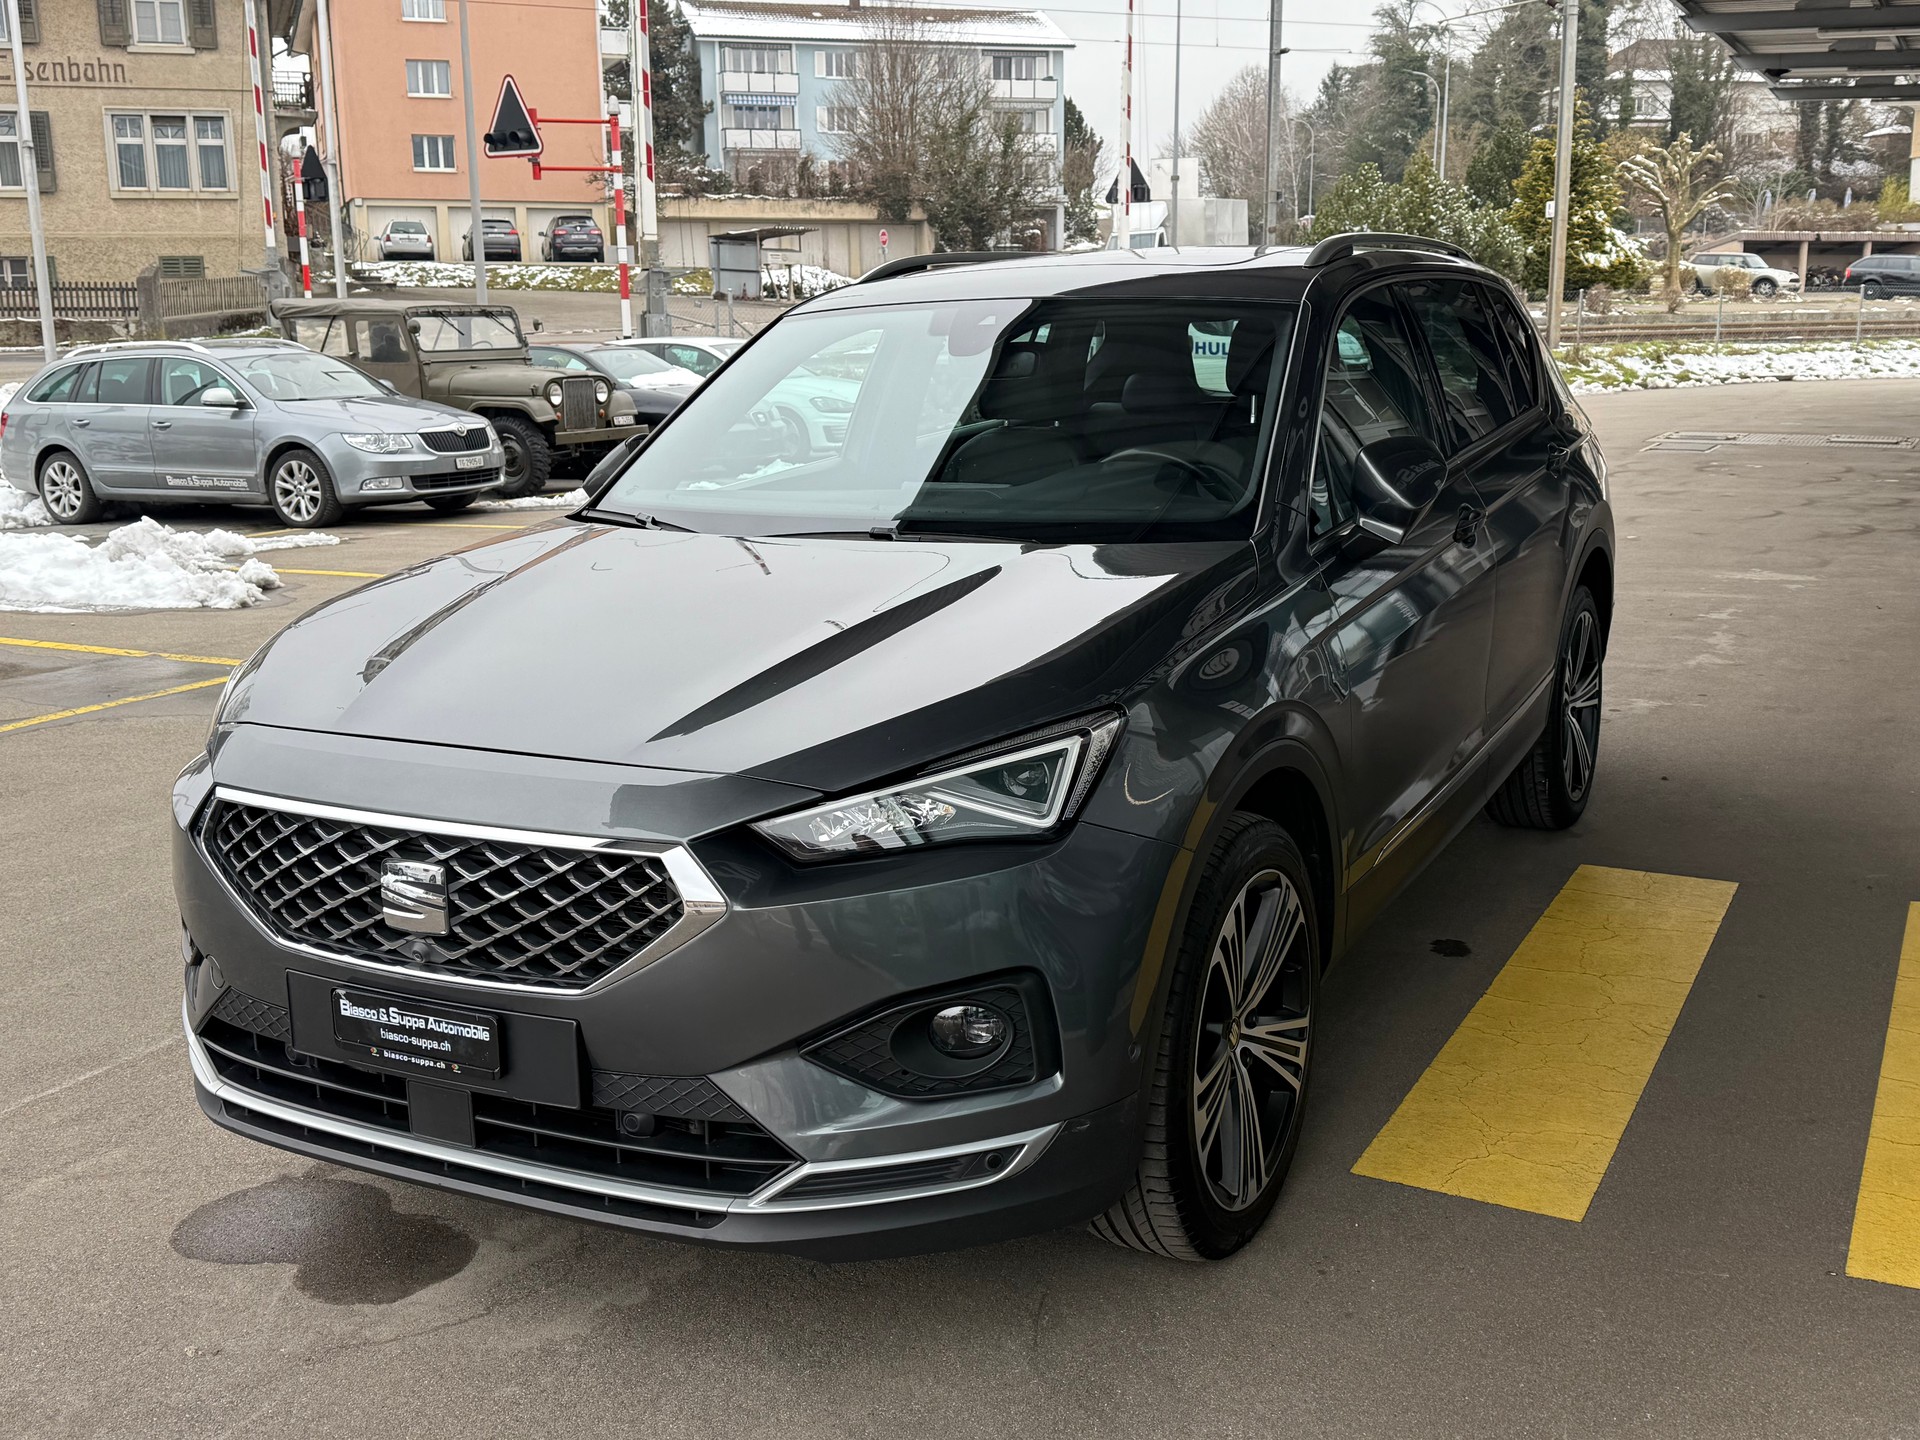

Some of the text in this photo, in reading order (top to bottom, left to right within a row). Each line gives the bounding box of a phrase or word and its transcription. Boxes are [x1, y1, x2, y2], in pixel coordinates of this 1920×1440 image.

[0, 55, 133, 83] senbahn.
[213, 478, 248, 488] Automobile
[339, 999, 490, 1041] Biasco & Suppa Automobile
[380, 1028, 452, 1052] biasco-suppa.ch
[383, 1050, 446, 1069] biasco-suppa.ch
